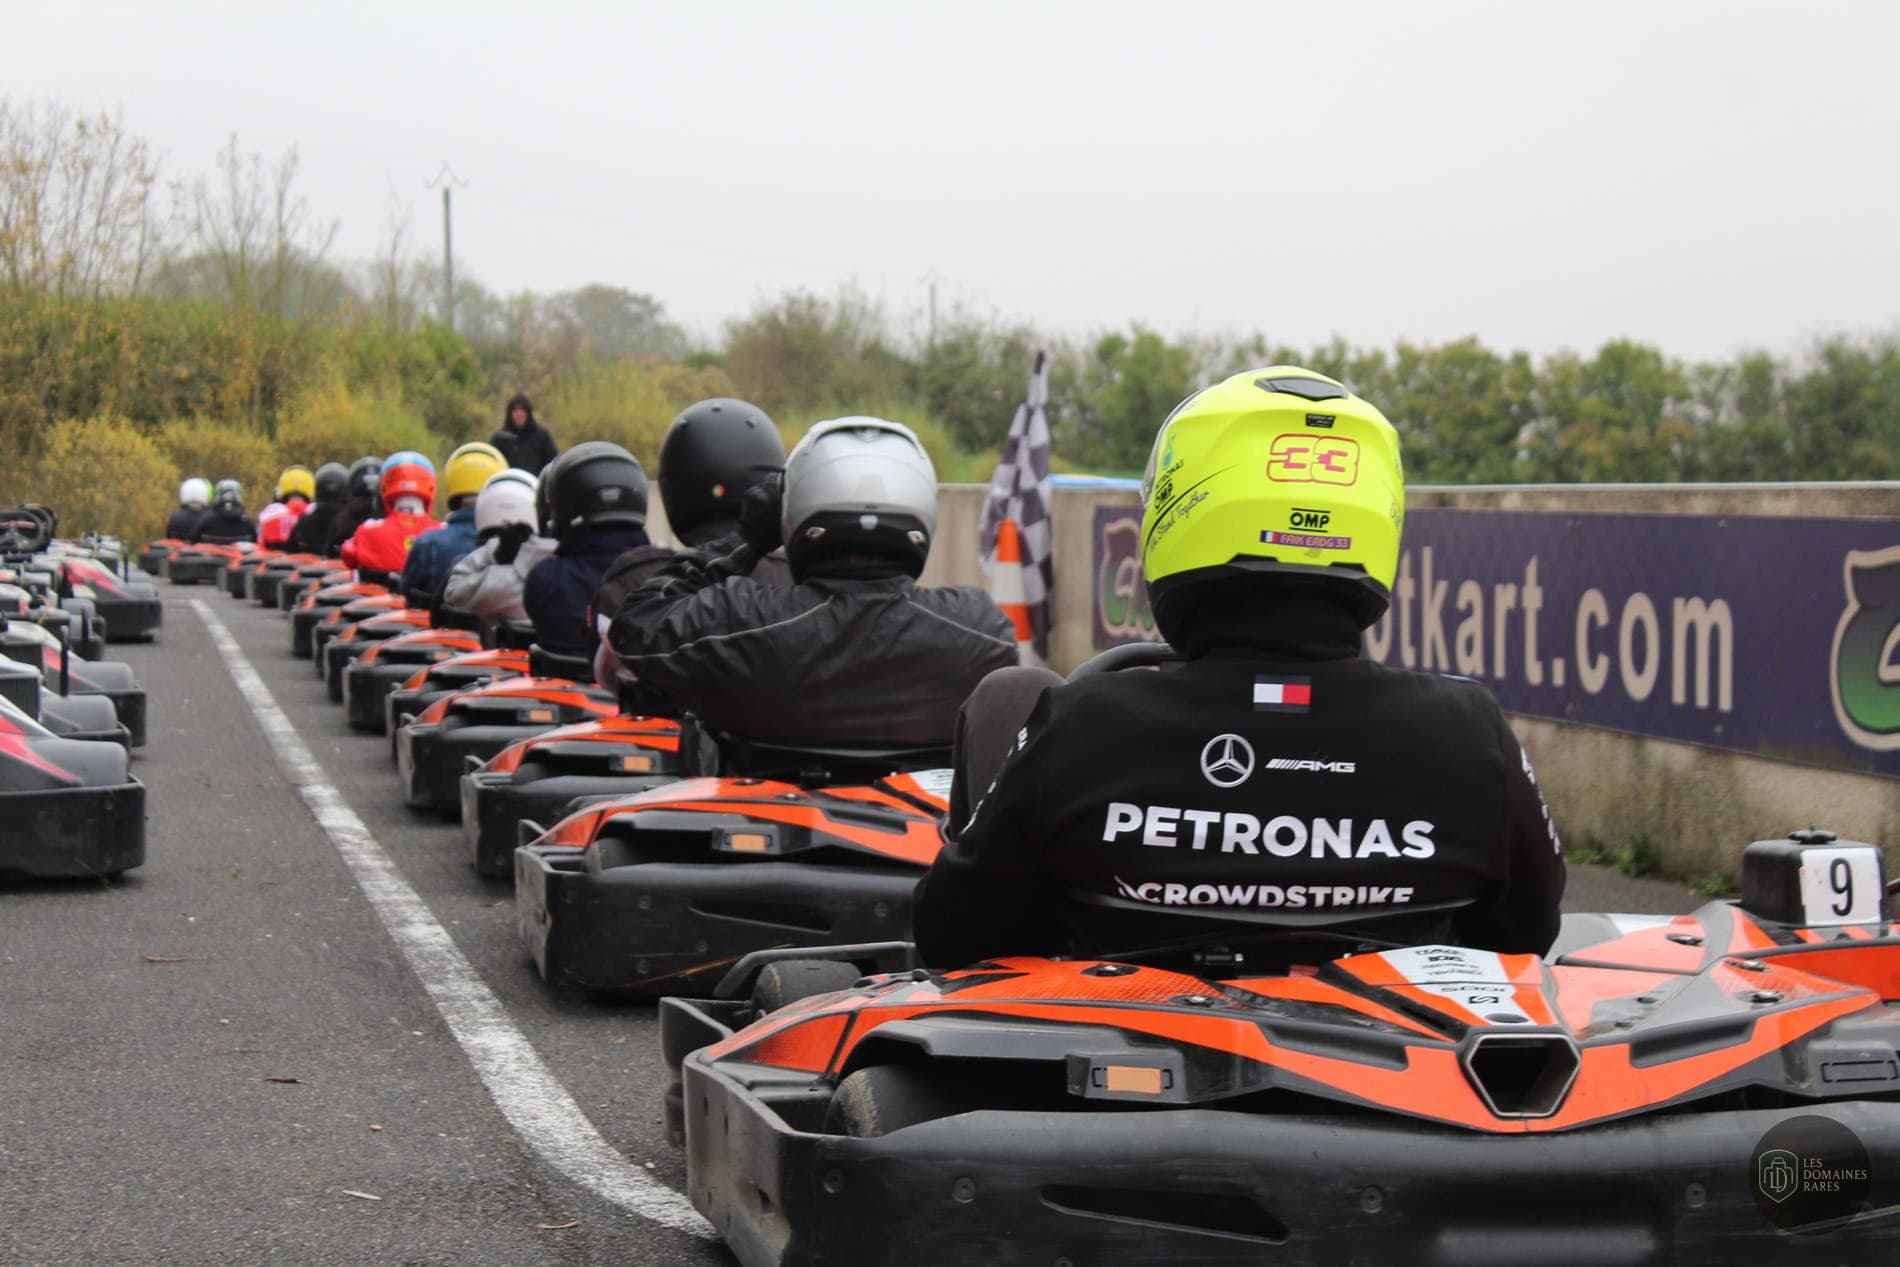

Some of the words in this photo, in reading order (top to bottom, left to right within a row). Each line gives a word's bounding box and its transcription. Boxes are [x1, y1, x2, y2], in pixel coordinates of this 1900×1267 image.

[1267, 433, 1360, 487] 33
[1290, 511, 1330, 529] OMP
[1102, 801, 1437, 861] PETRONAS
[1829, 857, 1853, 917] 9
